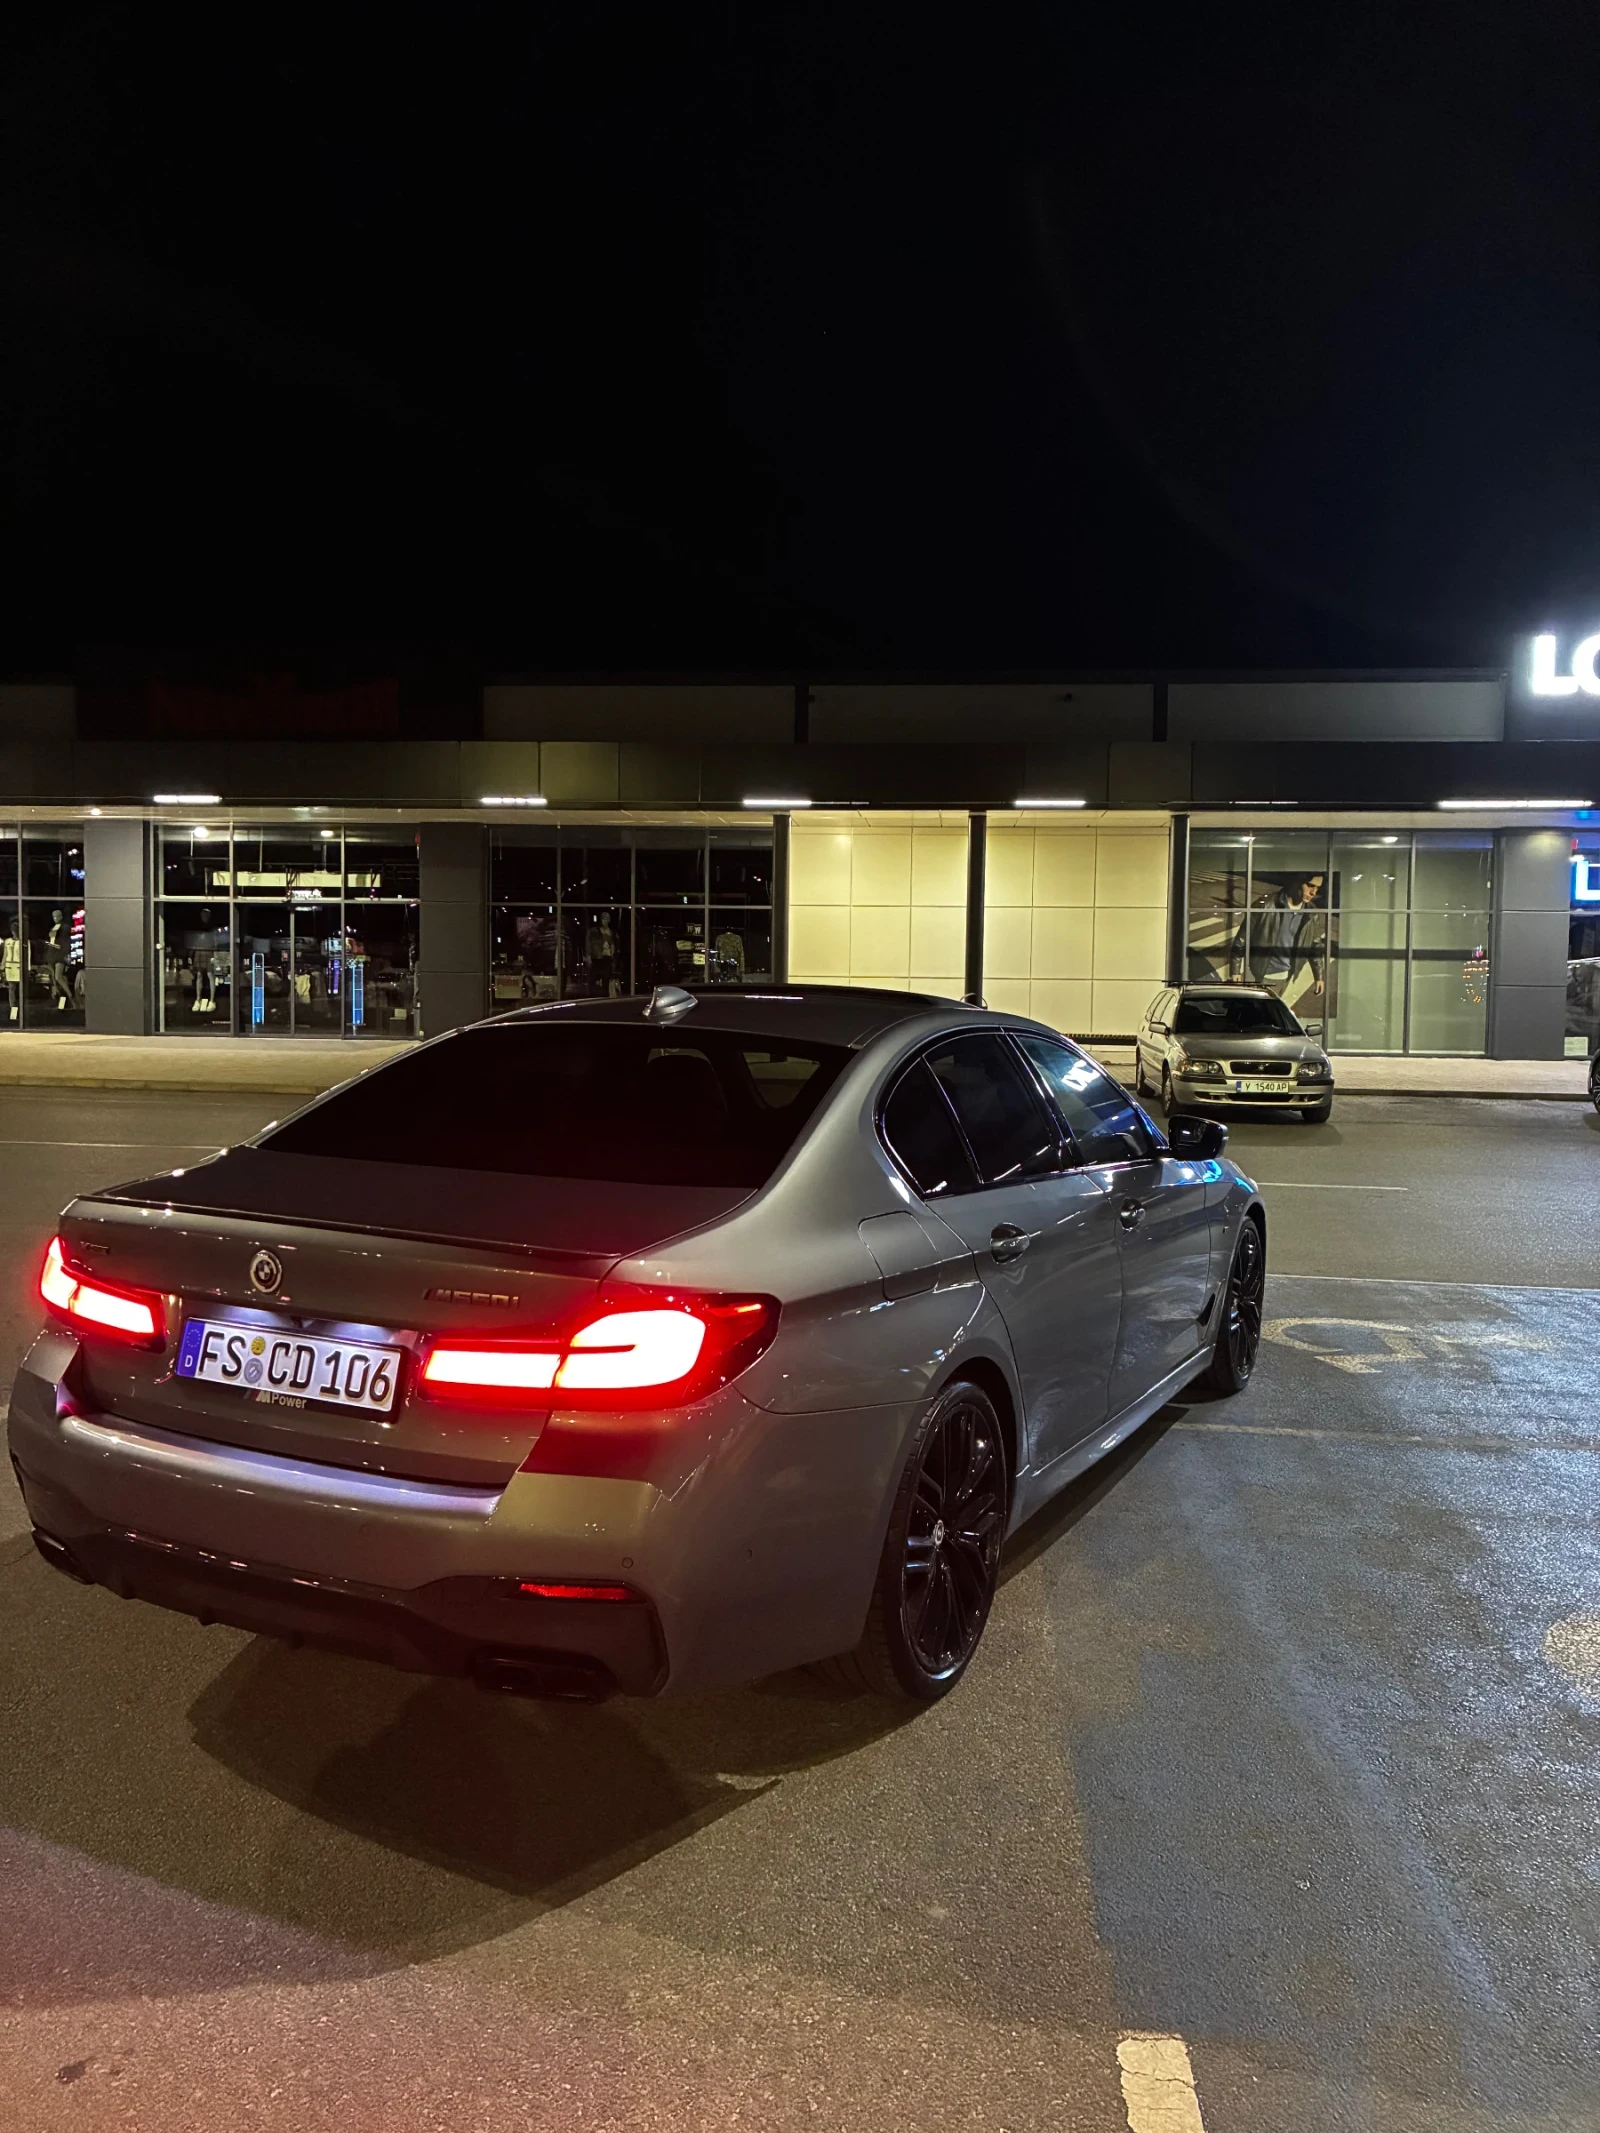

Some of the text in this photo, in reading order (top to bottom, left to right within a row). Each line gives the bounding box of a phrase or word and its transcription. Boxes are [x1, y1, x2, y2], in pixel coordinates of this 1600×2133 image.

[1255, 1082, 1275, 1092] 1540
[1276, 1082, 1287, 1092] AP
[184, 1354, 193, 1368] D
[198, 1330, 392, 1403] FS CD 106
